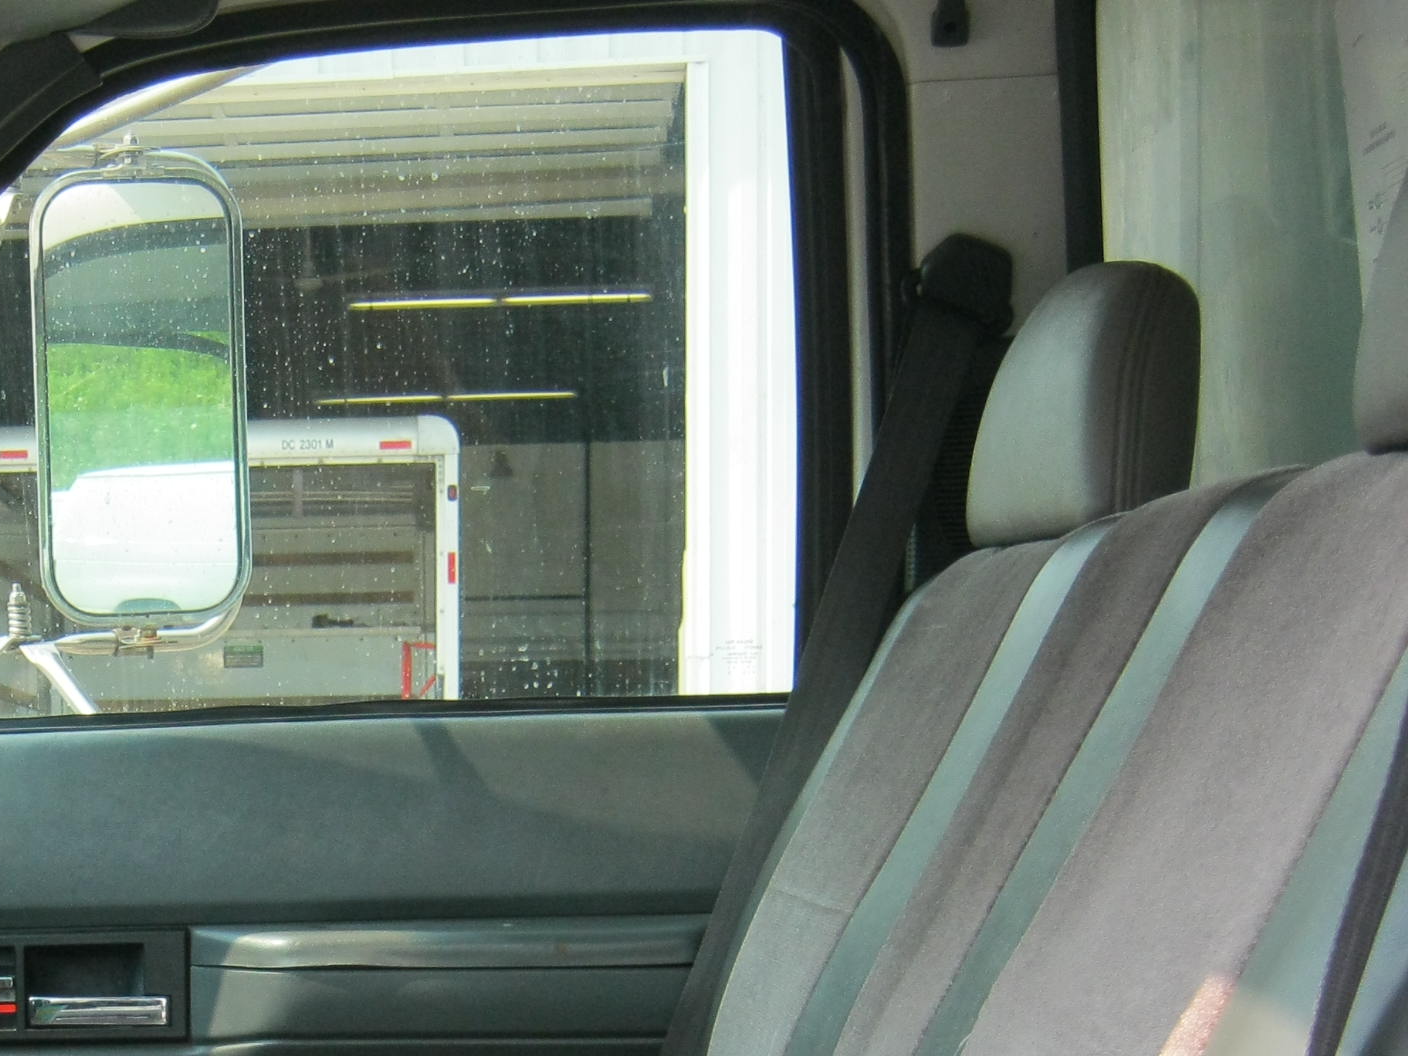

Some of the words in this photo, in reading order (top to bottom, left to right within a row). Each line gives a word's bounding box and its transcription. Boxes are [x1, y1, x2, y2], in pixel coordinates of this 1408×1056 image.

[281, 440, 295, 450] DC
[299, 440, 322, 450] 2301
[325, 439, 334, 449] M
